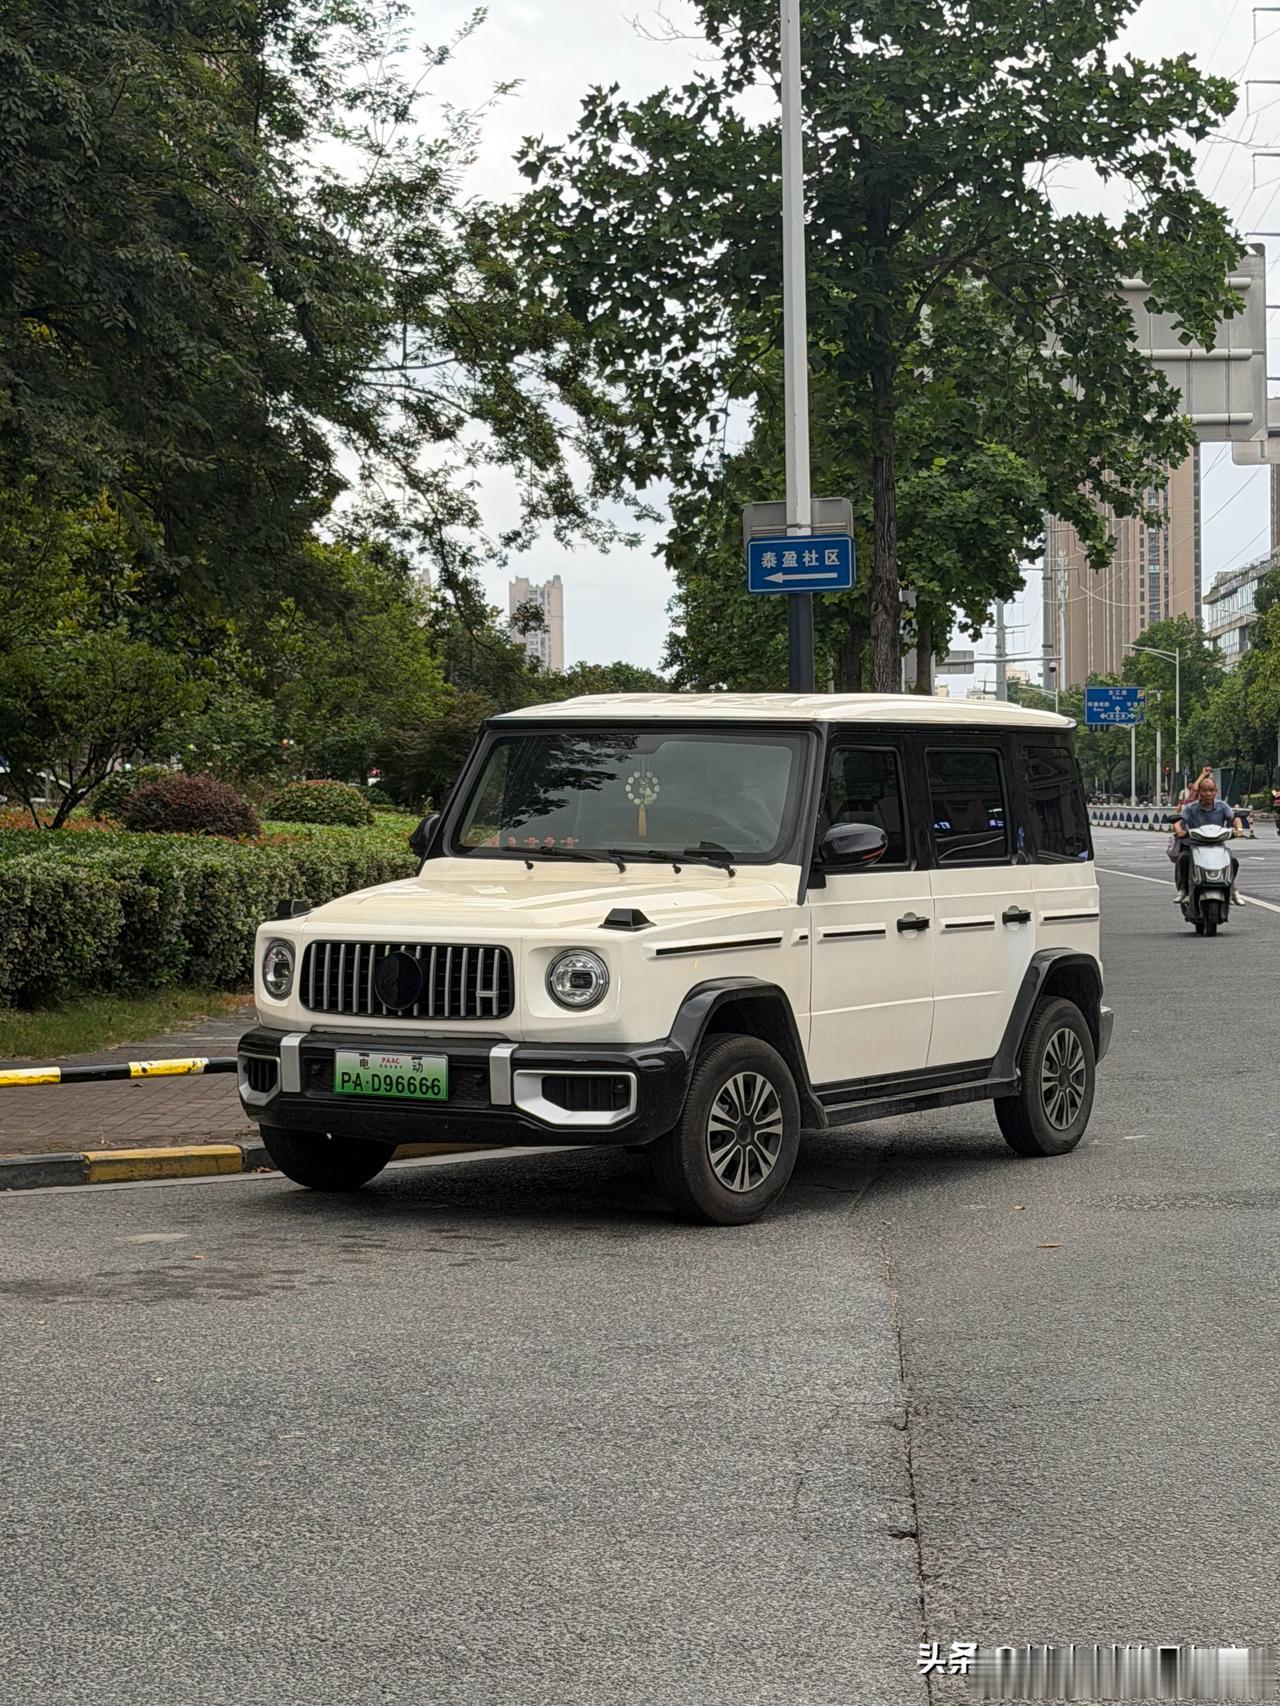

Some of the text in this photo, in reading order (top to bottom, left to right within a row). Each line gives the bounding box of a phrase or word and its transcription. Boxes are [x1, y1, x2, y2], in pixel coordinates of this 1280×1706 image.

[761, 549, 840, 569] 泰盈社区
[359, 1058, 370, 1070] 电
[381, 1056, 400, 1065] PAAC
[412, 1061, 424, 1073] 动
